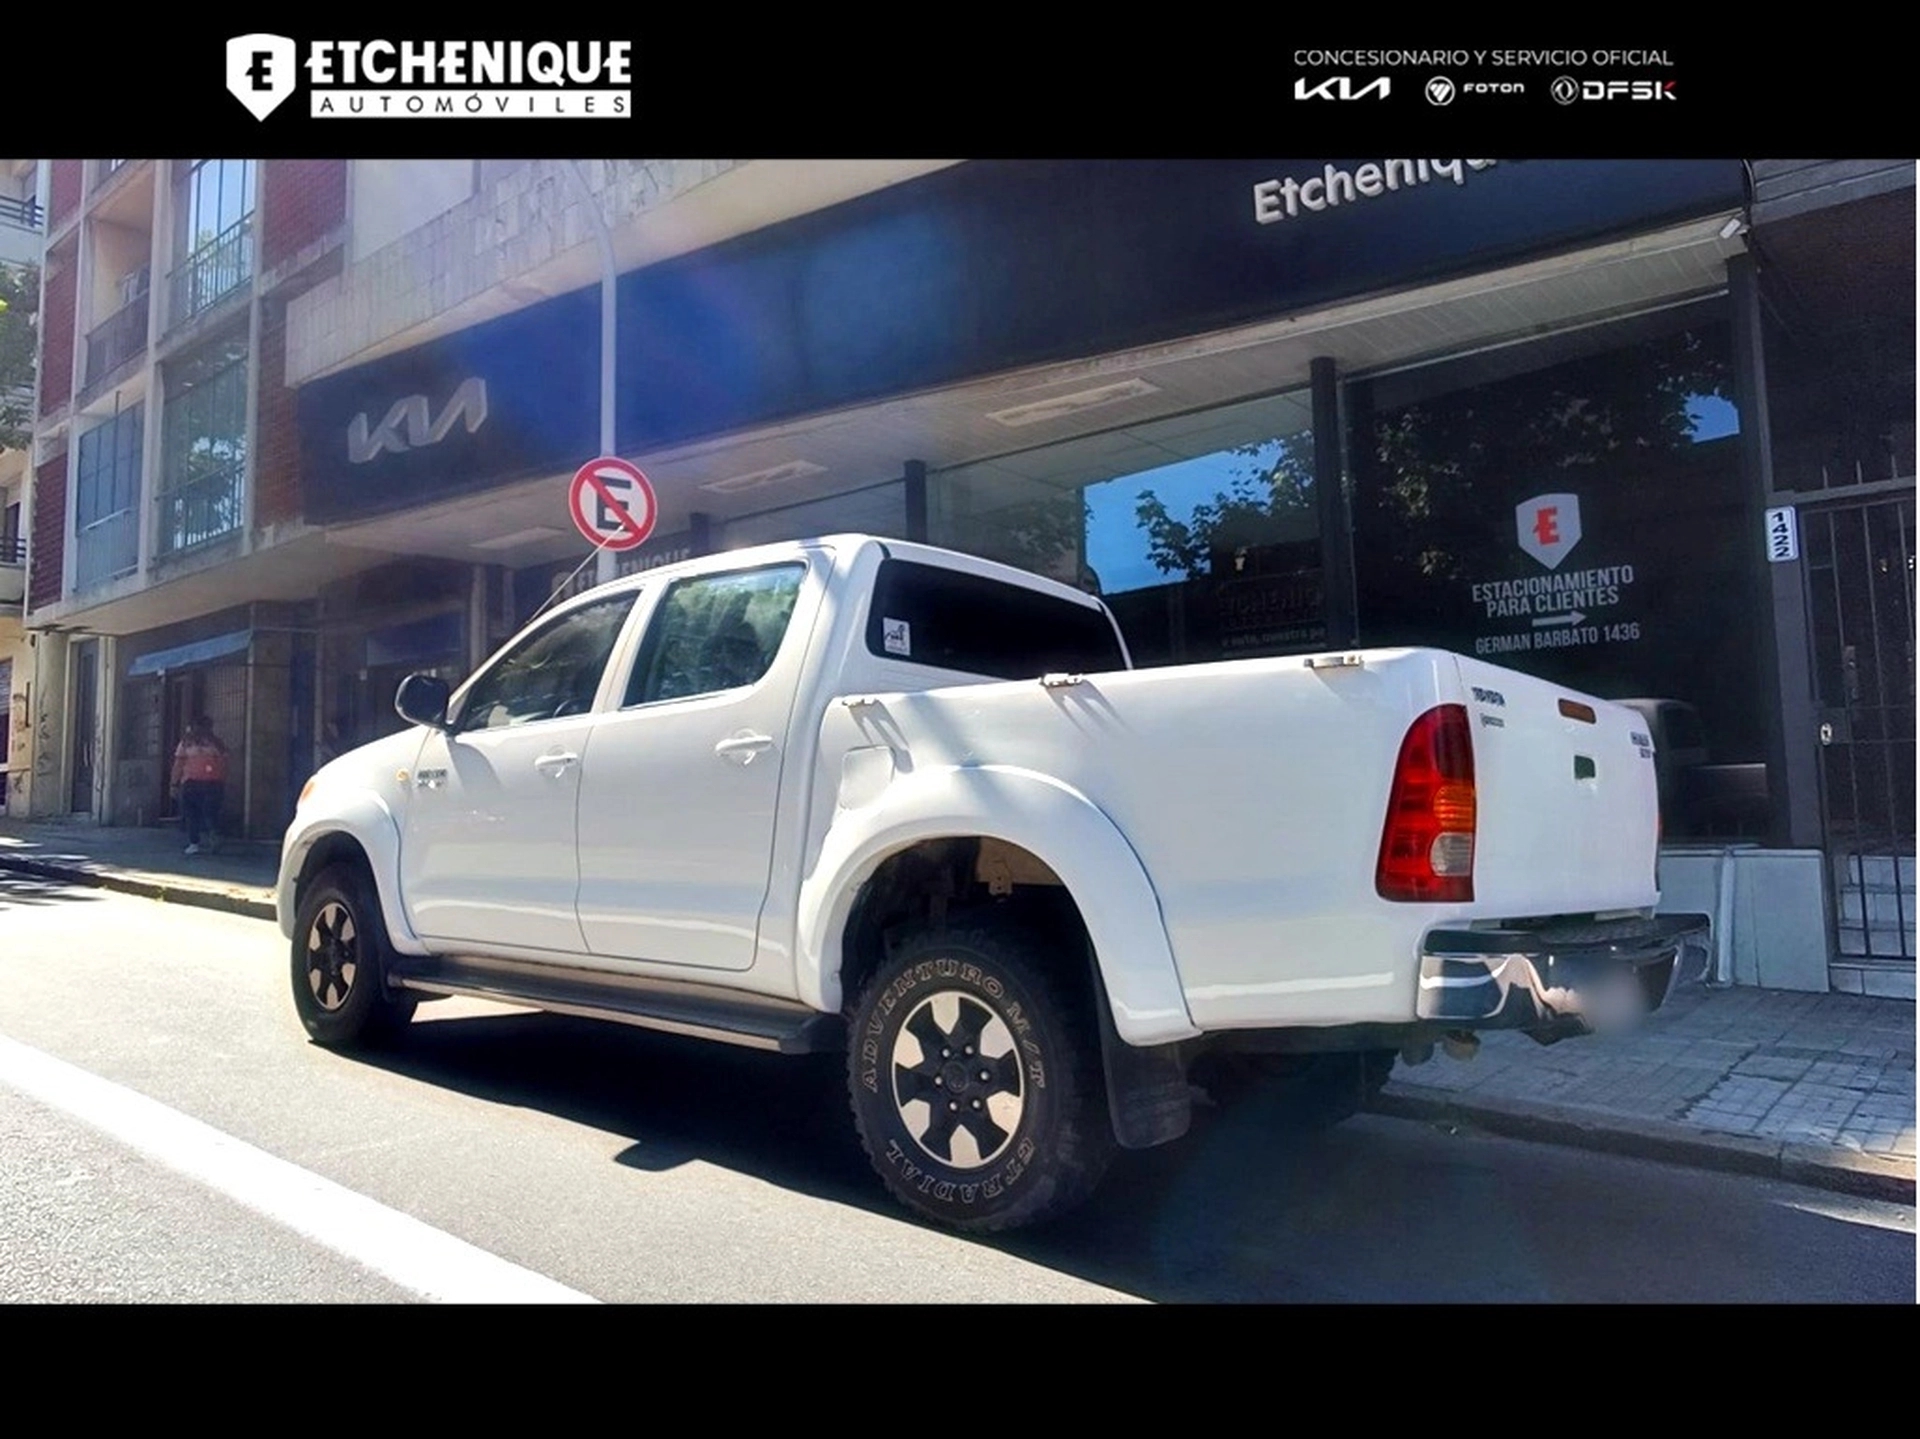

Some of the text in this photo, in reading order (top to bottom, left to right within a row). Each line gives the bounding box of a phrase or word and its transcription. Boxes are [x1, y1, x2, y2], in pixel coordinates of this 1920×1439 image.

[596, 475, 632, 532] E
[1772, 511, 1791, 559] 1422
[1472, 564, 1634, 603] ESTACIONAMIENTO
[1486, 586, 1620, 618] PARA CLIENTES
[1475, 622, 1641, 654] GERMAN BARBATO 1436
